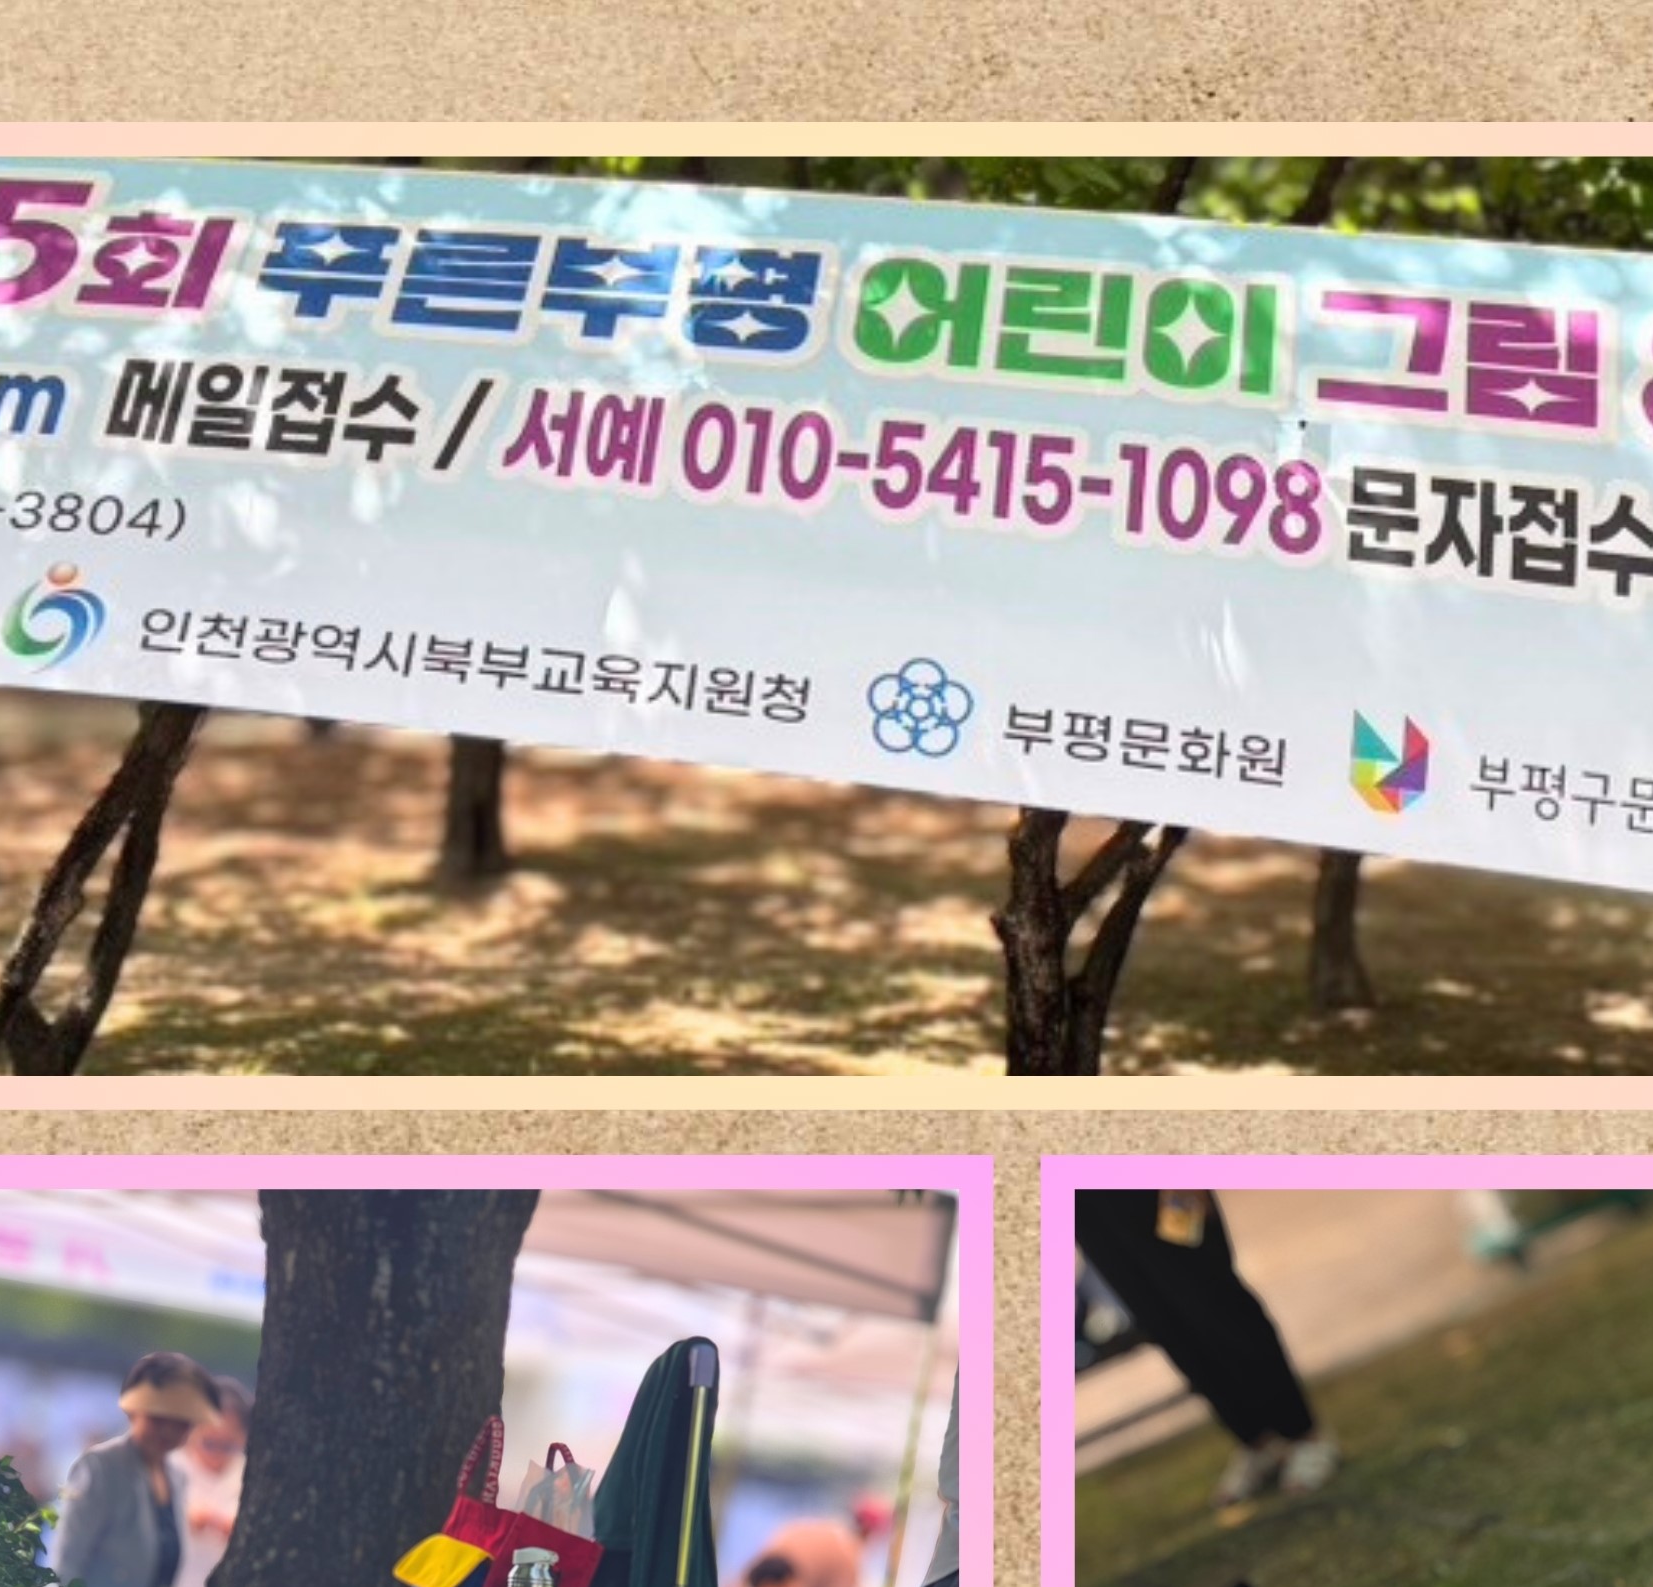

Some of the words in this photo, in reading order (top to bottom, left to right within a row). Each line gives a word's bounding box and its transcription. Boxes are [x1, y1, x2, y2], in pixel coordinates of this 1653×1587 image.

[257, 219, 827, 353] 푸른부평
[854, 256, 1284, 395] 어린이
[1316, 290, 1599, 429] 그림
[103, 356, 423, 462] 메일접수
[433, 380, 492, 471] /
[500, 389, 658, 486] 서예
[681, 400, 1324, 556] 010-5415-1098
[138, 608, 812, 726] 인천광역시북부교육지원청
[1002, 703, 1289, 787] 부평문화원
